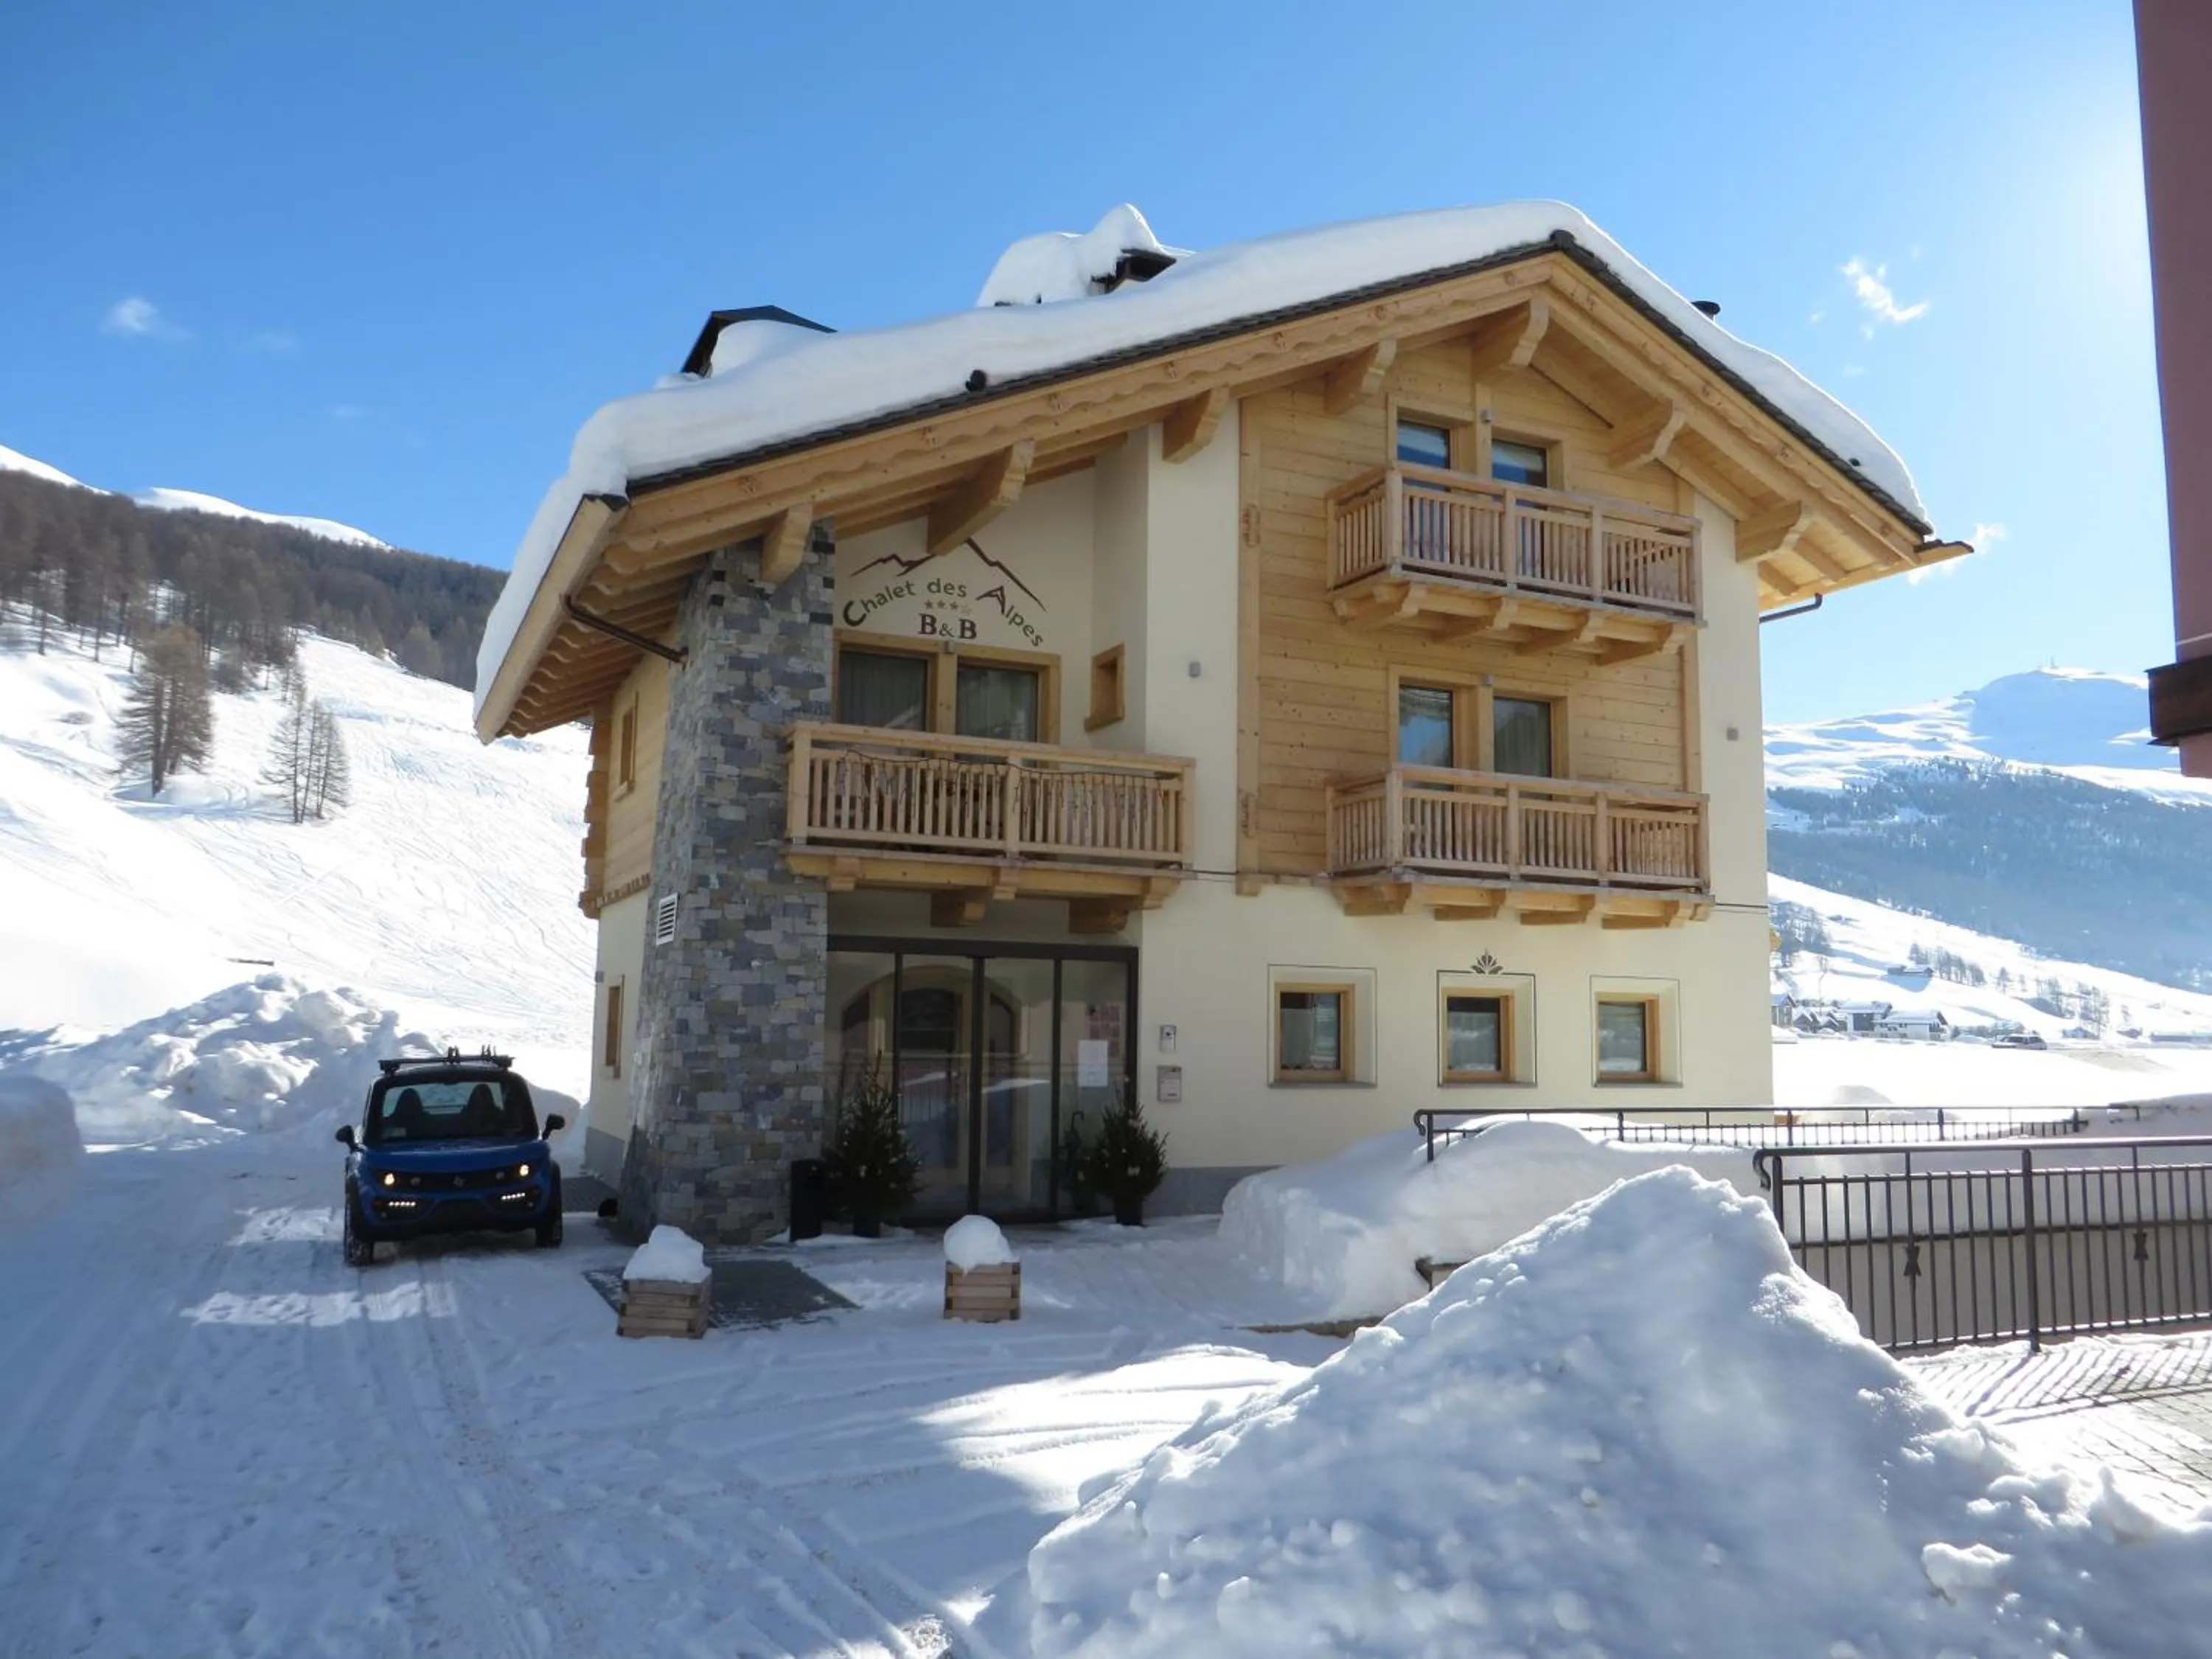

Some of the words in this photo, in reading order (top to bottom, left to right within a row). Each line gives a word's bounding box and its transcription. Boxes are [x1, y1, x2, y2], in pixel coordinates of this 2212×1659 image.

[844, 580, 917, 627] Chalet
[927, 577, 967, 598] des
[975, 585, 1043, 647] Alpes
[919, 613, 977, 639] B&B
